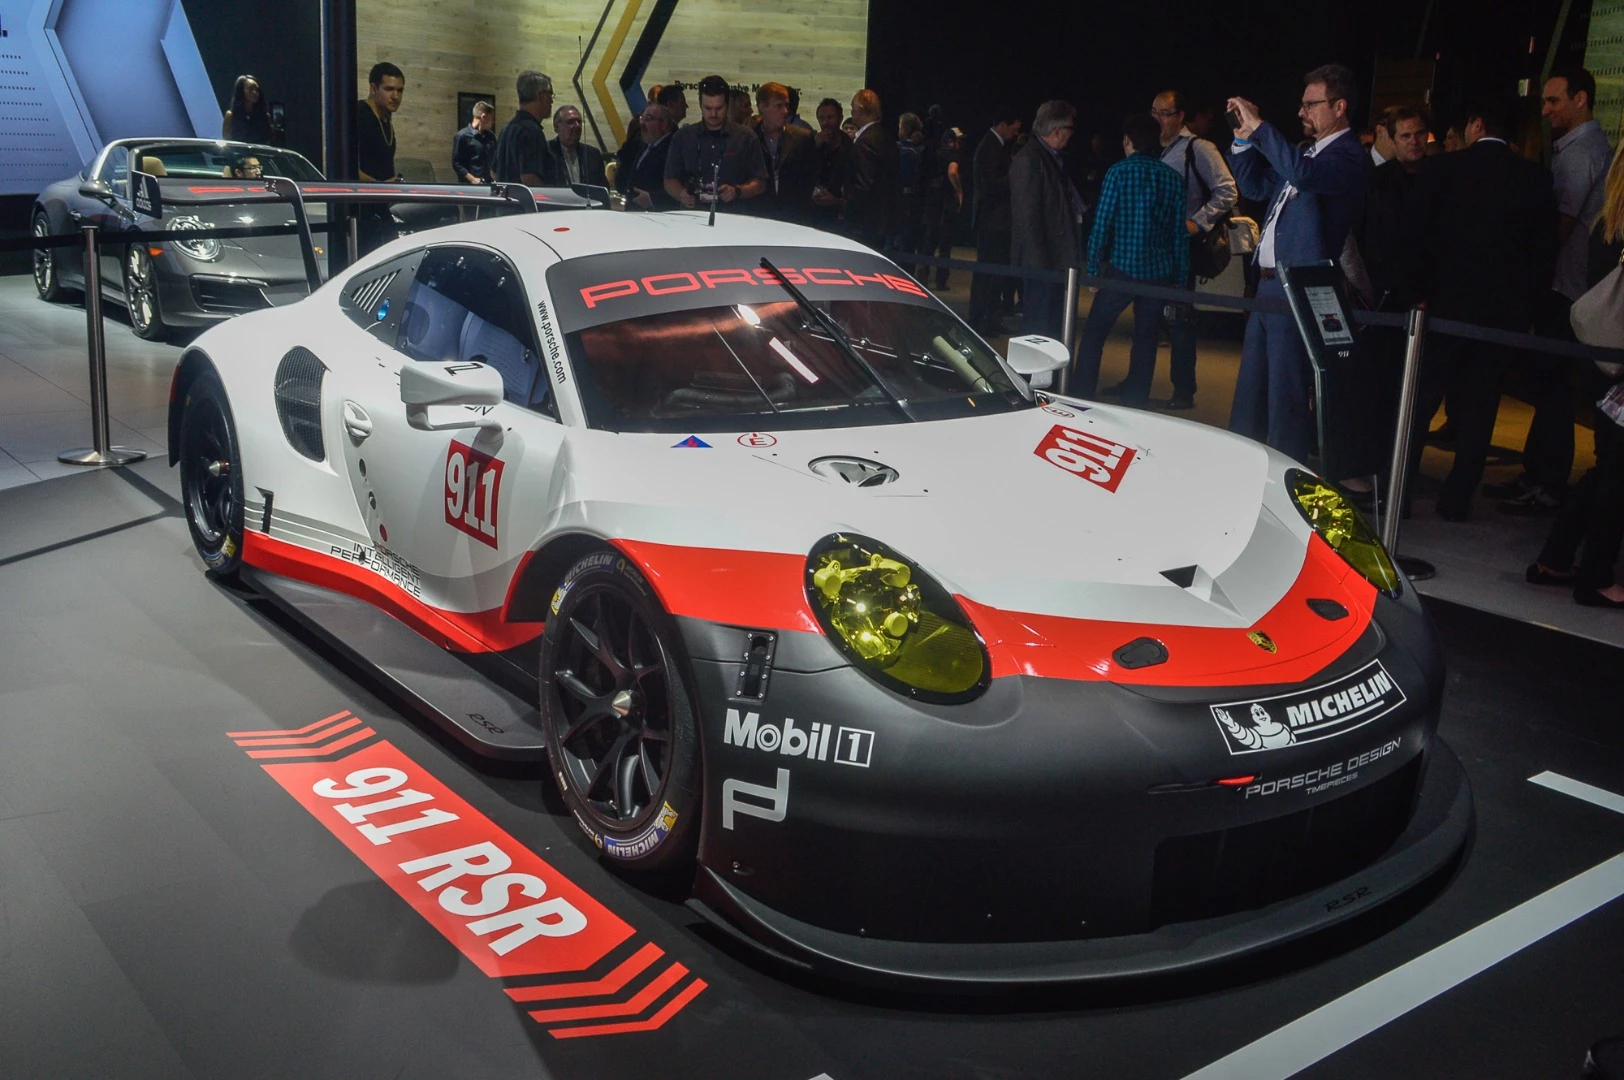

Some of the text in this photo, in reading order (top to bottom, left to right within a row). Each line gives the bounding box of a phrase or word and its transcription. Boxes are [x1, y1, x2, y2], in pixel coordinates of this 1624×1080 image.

[580, 268, 928, 309] PORSCHE
[537, 300, 567, 385] www.porsche.com
[1045, 429, 1127, 483] 911
[446, 452, 496, 538] 911
[373, 541, 420, 577] PORSCHE
[564, 554, 613, 586] MICHELIN
[1286, 670, 1392, 728] MICHELIN
[723, 708, 832, 762] Mobil
[1245, 736, 1402, 799] PORSCHE DESIGN
[1306, 771, 1359, 795] TIMEPIECES
[313, 767, 588, 957] 911 RSR
[607, 831, 660, 858] MICHELIN
[1323, 886, 1374, 913] RSR
